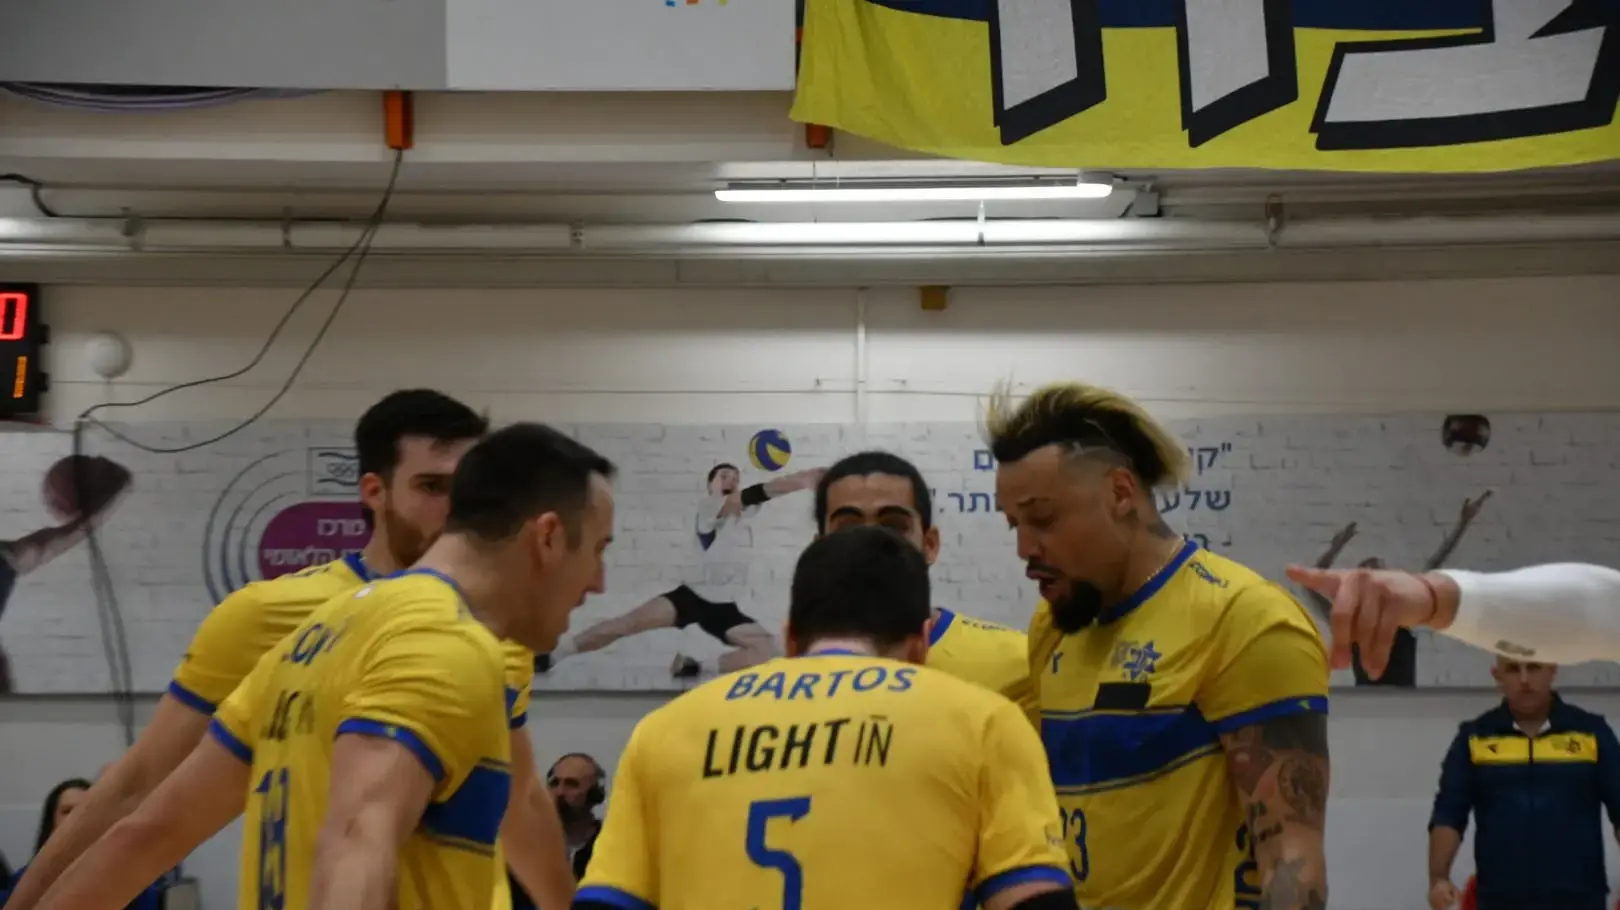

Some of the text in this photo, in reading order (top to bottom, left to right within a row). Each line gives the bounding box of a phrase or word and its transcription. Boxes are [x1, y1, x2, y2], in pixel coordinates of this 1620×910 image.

[1160, 486, 1231, 514] שלע
[725, 666, 917, 701] BARTOS
[745, 795, 812, 910] 5
